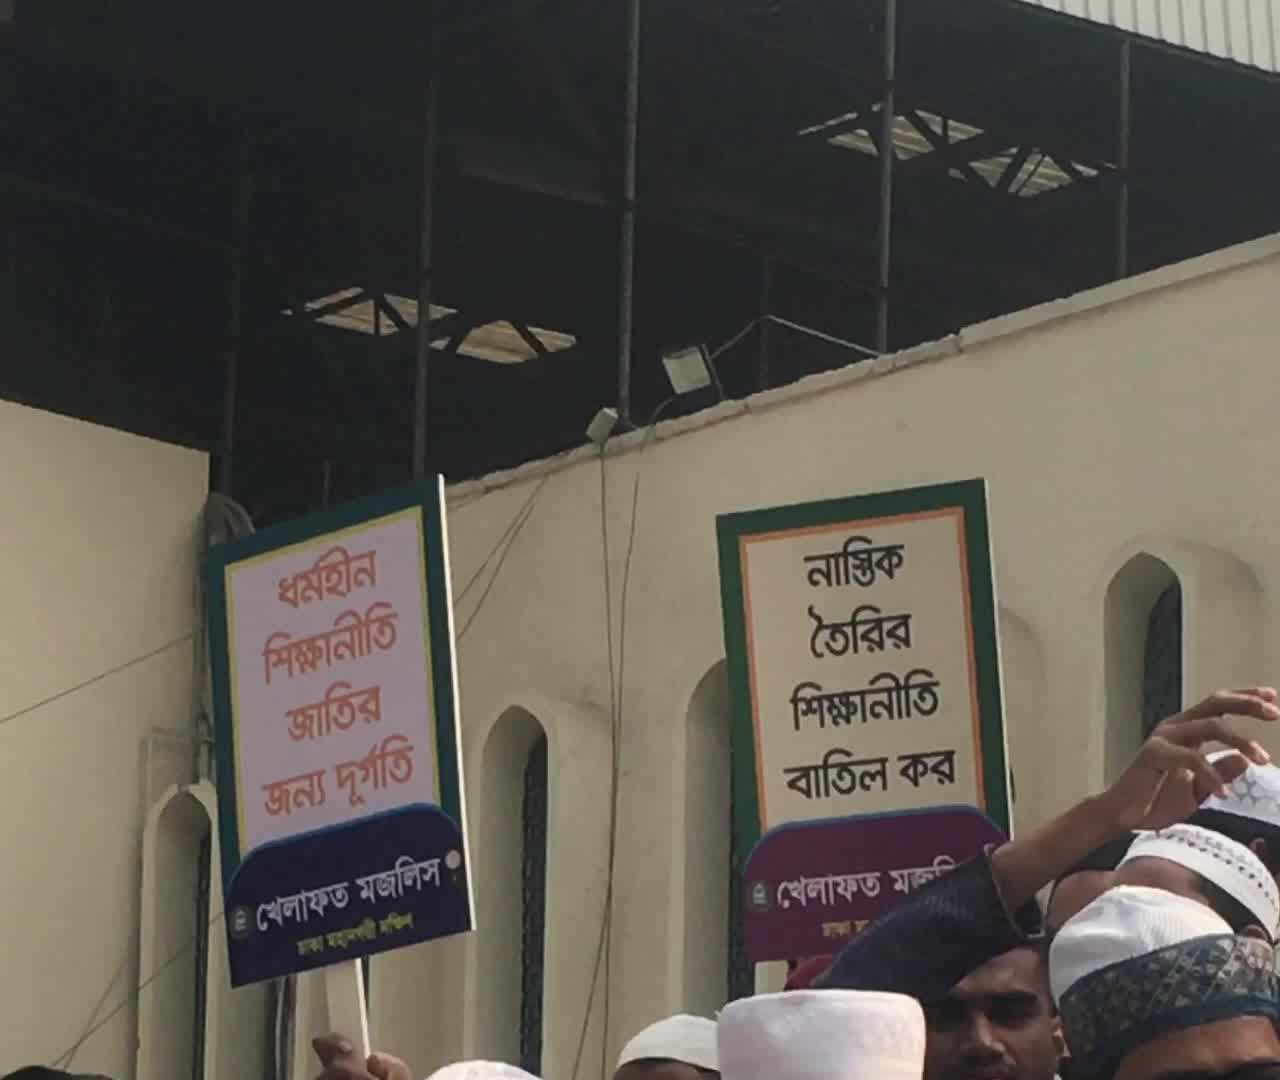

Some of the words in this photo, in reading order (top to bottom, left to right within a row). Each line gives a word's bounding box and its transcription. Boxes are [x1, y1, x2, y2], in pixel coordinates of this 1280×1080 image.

[278, 546, 377, 608] ধর্মহীন
[804, 536, 904, 588] নাস্তিক
[262, 603, 398, 684] শিক্ষানীতি
[808, 605, 911, 658] তৈরির
[285, 681, 382, 742] জাতির
[790, 668, 939, 731] শিক্ষানীতি
[262, 770, 327, 817] জন্য
[784, 748, 887, 800] বাতিল
[898, 749, 955, 788] কর
[256, 882, 349, 931] খেলাফত
[355, 856, 440, 903] মজলিস
[777, 872, 880, 908] খেলাফত
